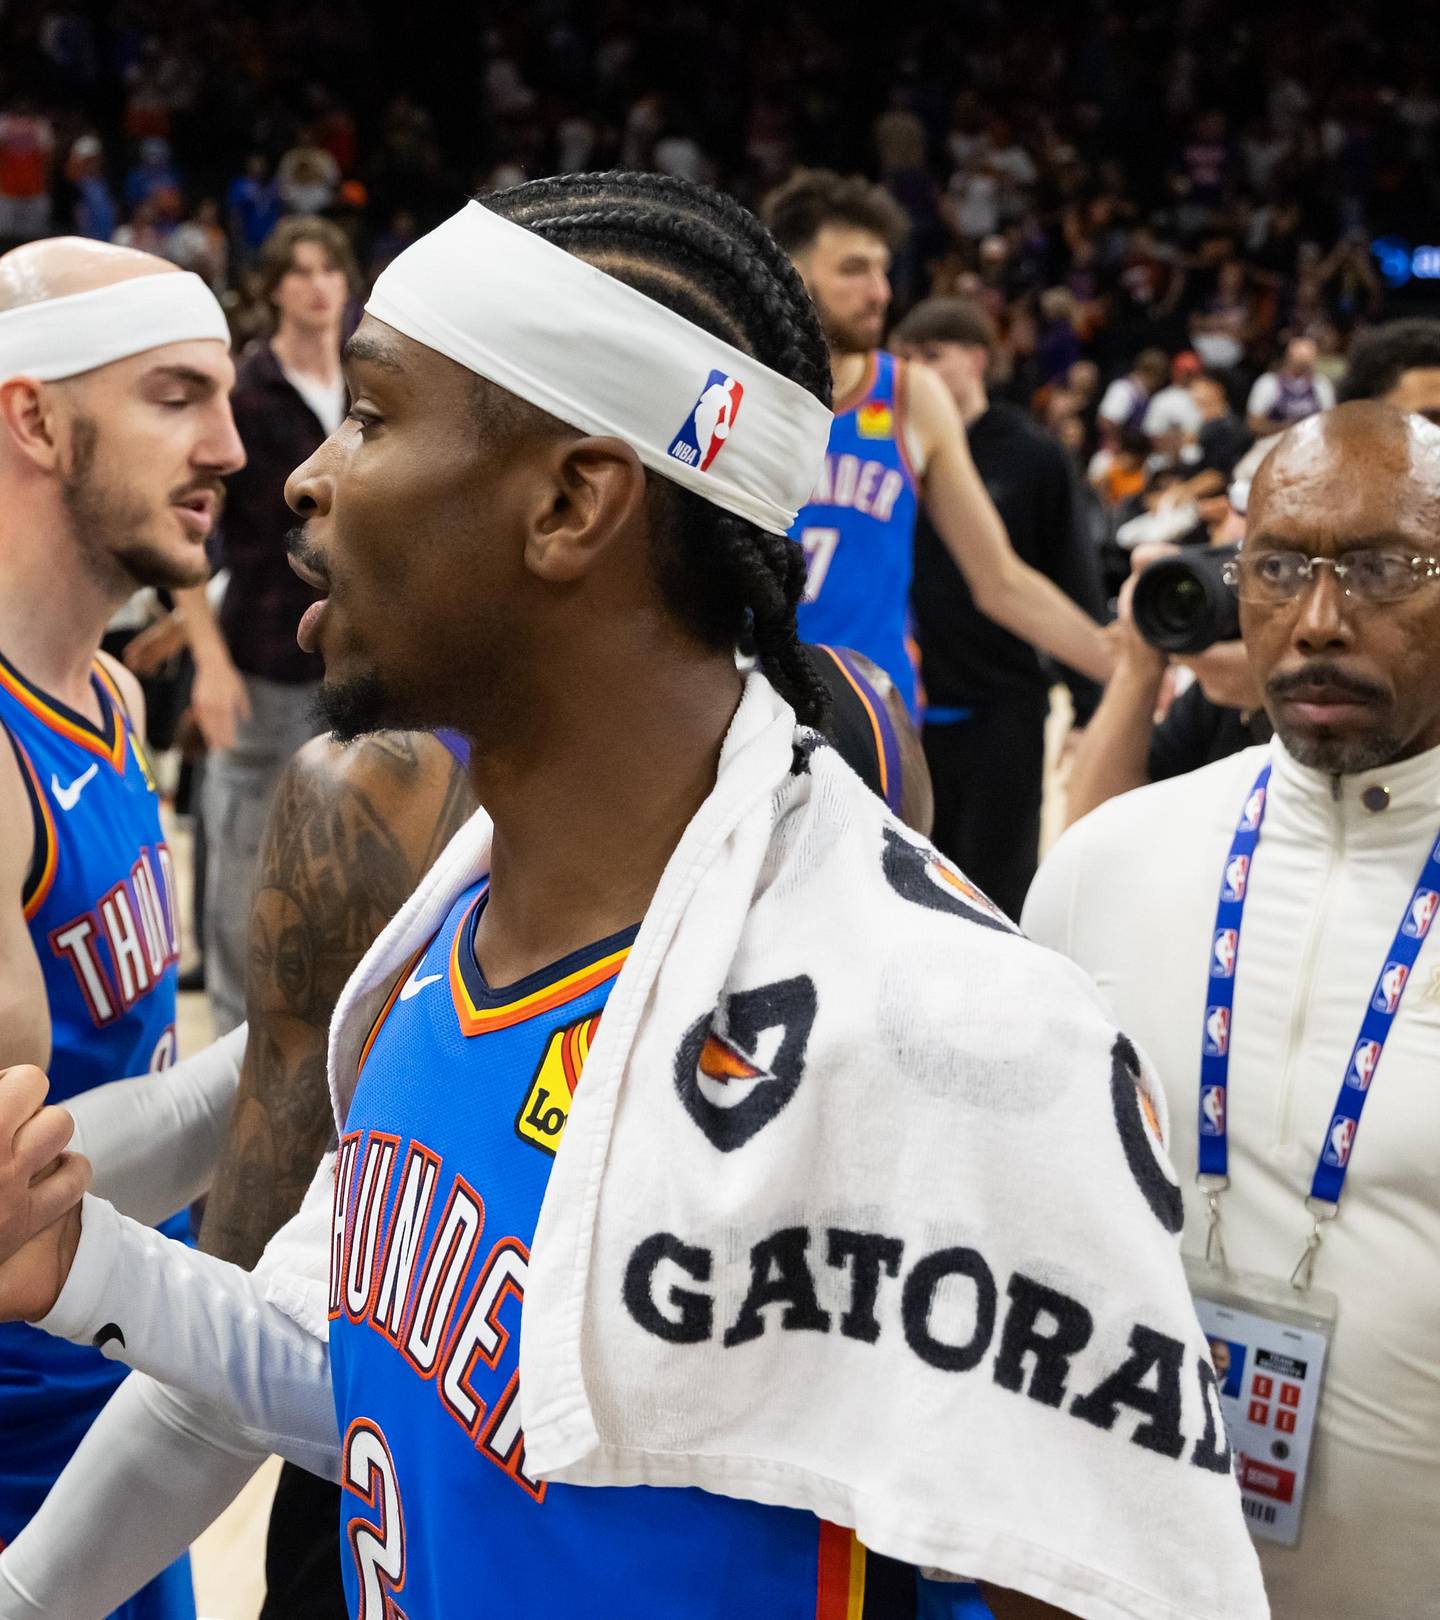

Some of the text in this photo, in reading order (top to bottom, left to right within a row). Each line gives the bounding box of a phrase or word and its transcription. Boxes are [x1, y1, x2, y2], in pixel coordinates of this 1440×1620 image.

[671, 440, 698, 465] NBA
[801, 527, 840, 603] 7
[525, 1088, 568, 1135] Lo
